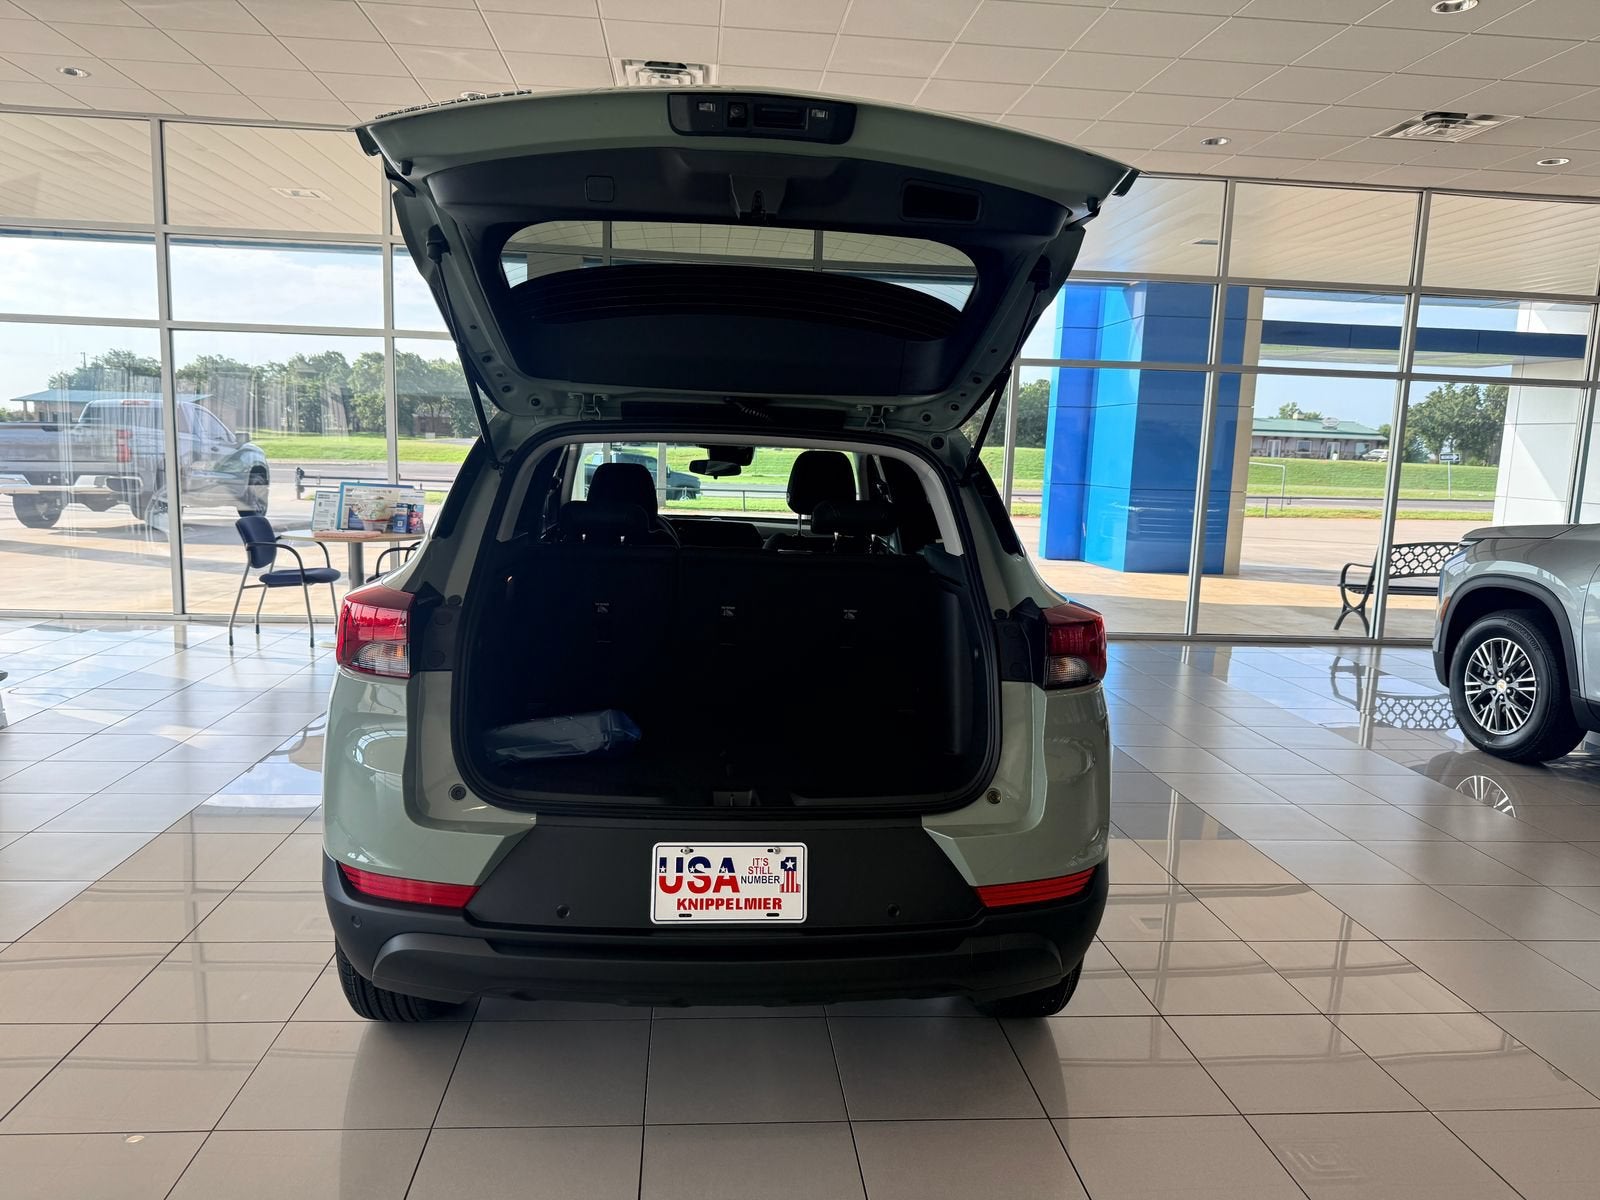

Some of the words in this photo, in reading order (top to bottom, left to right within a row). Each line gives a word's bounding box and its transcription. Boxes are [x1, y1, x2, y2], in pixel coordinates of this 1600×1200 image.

[752, 858, 769, 866] IT'S
[659, 856, 740, 894] USA
[741, 875, 780, 884] NUMBER
[779, 857, 800, 893] 1
[747, 866, 773, 875] STILL
[677, 898, 782, 911] KNIPPELMIER
